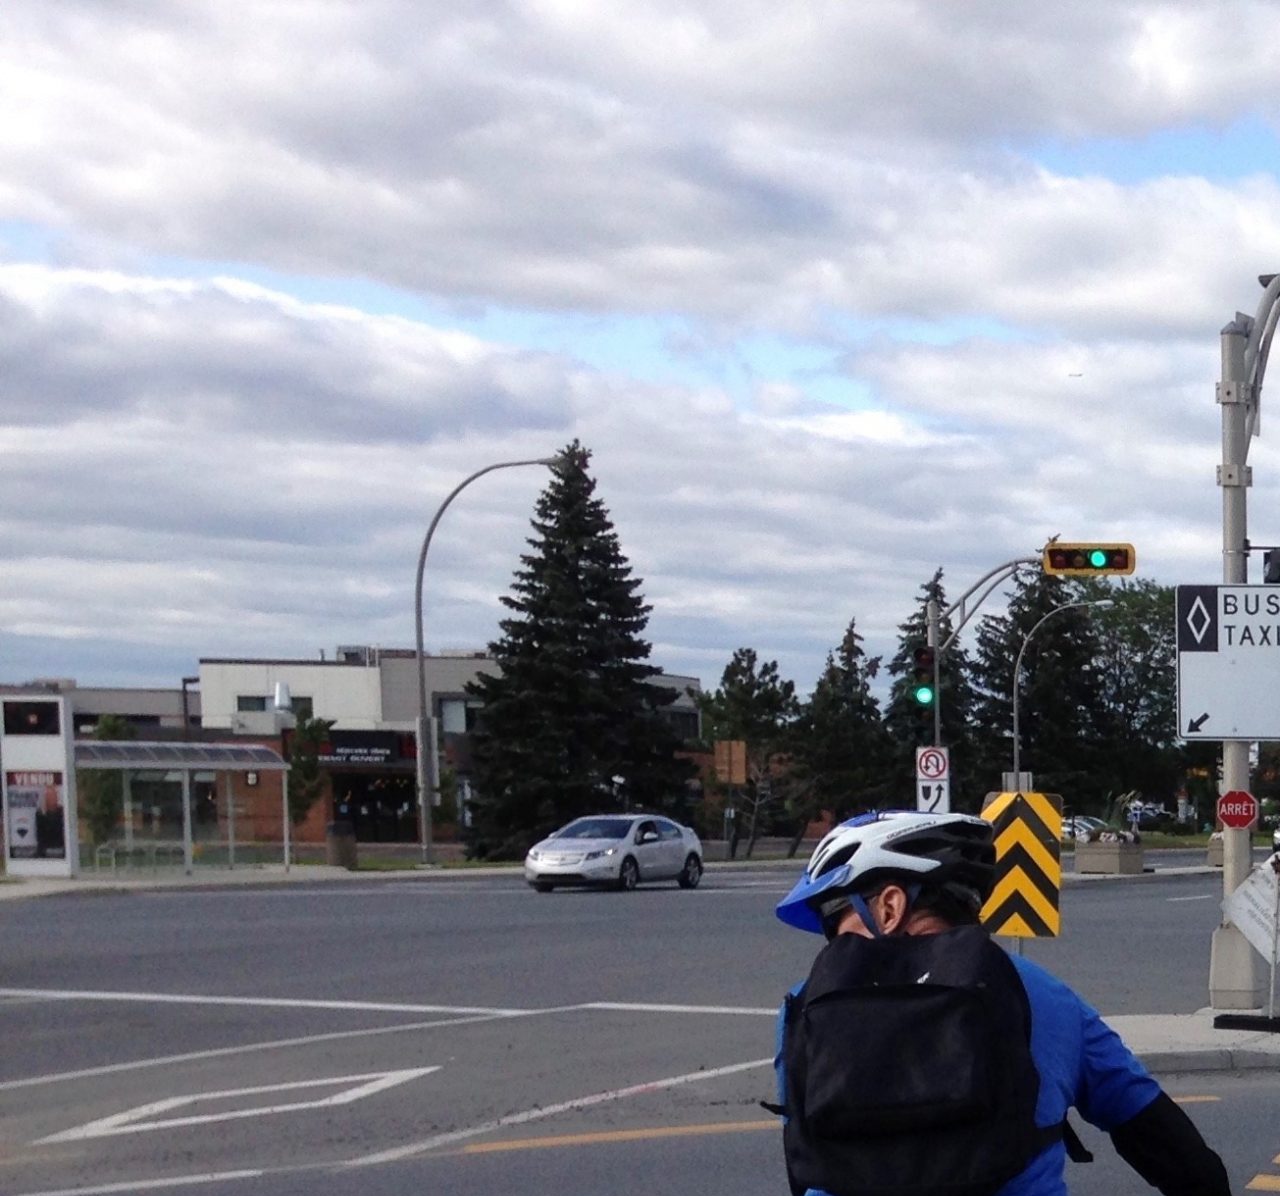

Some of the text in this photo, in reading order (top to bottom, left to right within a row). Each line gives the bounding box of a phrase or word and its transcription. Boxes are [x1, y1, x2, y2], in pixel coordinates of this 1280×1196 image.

[1223, 594, 1280, 616] BUS
[1223, 625, 1280, 646] TAXI
[1220, 801, 1254, 816] ARRÊT
